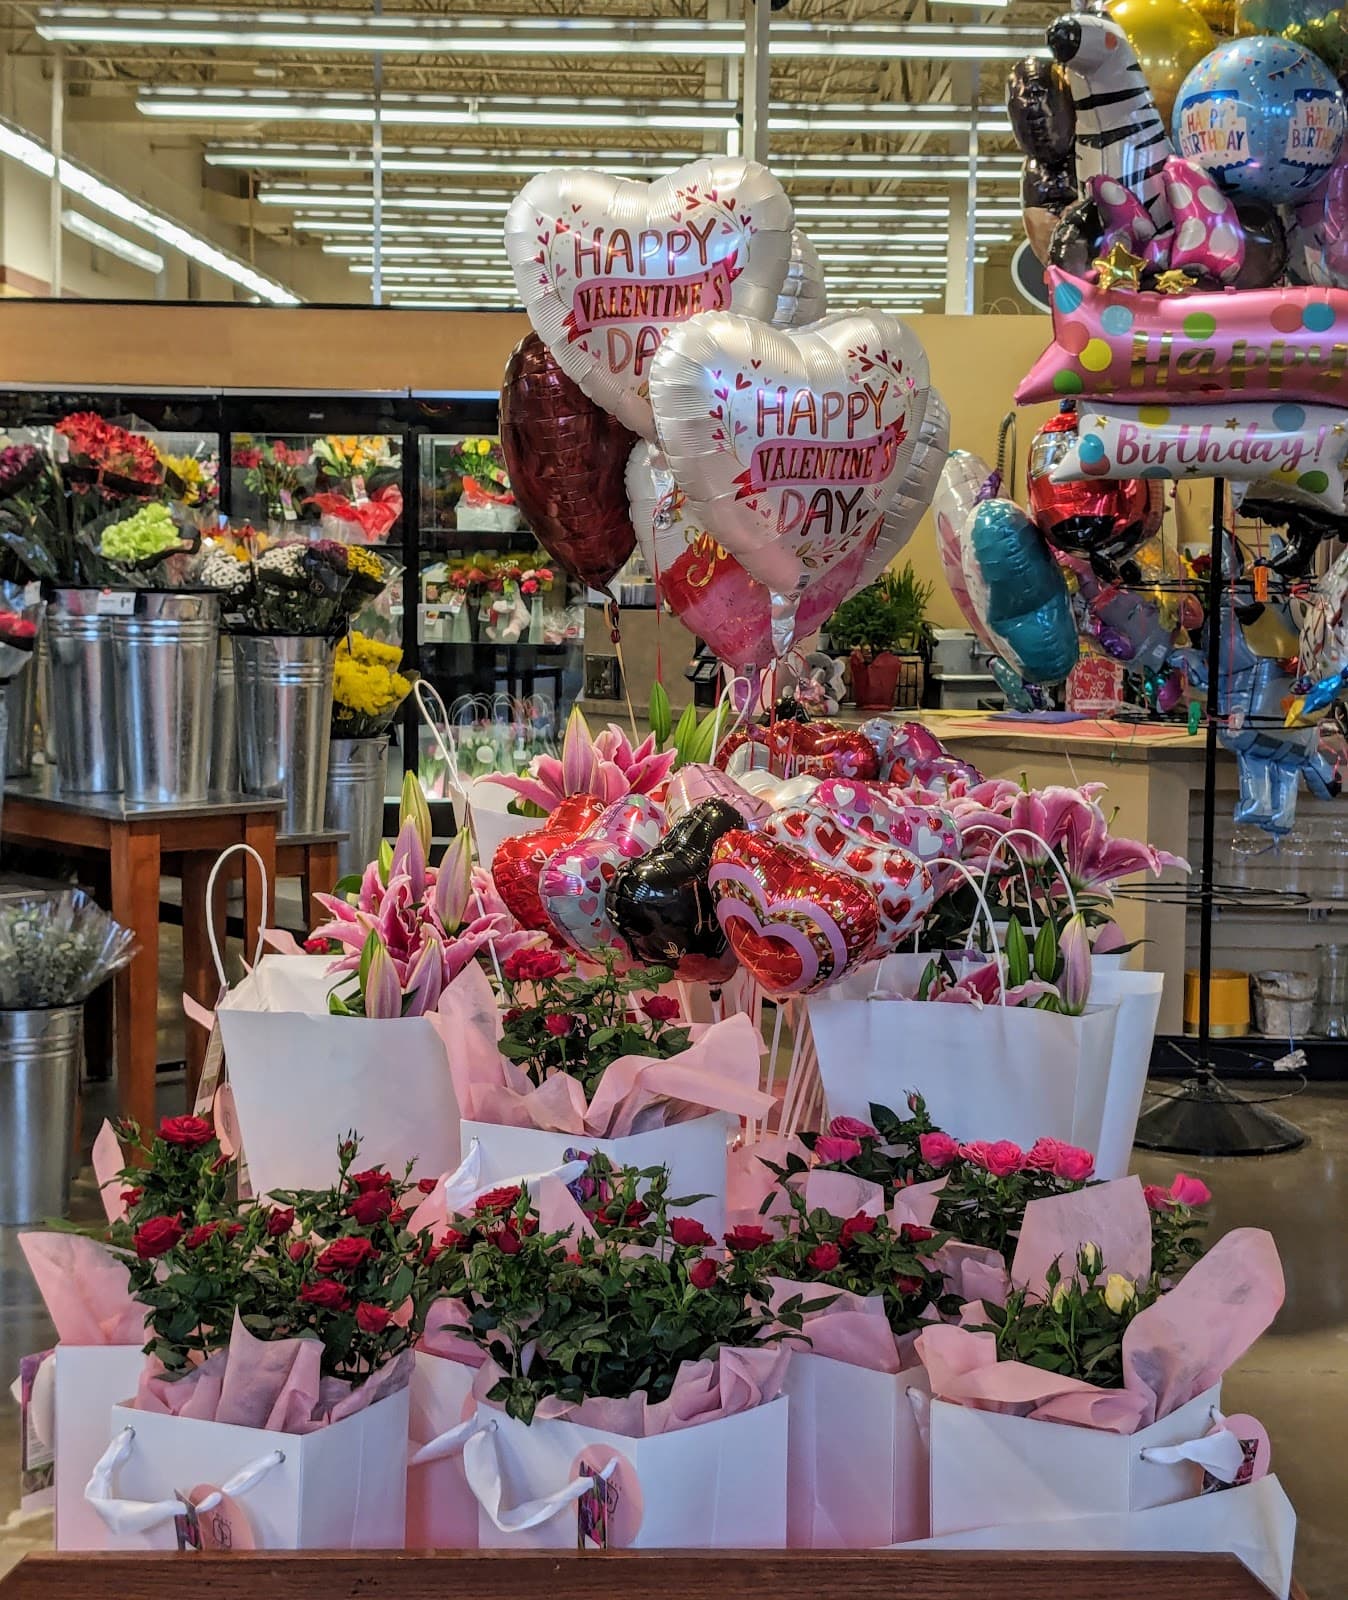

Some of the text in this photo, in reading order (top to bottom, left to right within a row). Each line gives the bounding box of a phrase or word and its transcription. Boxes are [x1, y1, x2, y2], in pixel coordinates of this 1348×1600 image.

[1181, 129, 1245, 158] BIRTHDAY
[1187, 107, 1226, 133] HAPPY
[574, 217, 717, 279] HAPPY
[578, 271, 725, 323] VALENTINE'S
[607, 325, 669, 376] DA
[1130, 330, 1348, 391] Happy
[757, 380, 889, 439] HAPPY
[758, 436, 893, 482] VALENTINE'S
[1116, 422, 1327, 473] Birthday!
[777, 487, 865, 537] DAY
